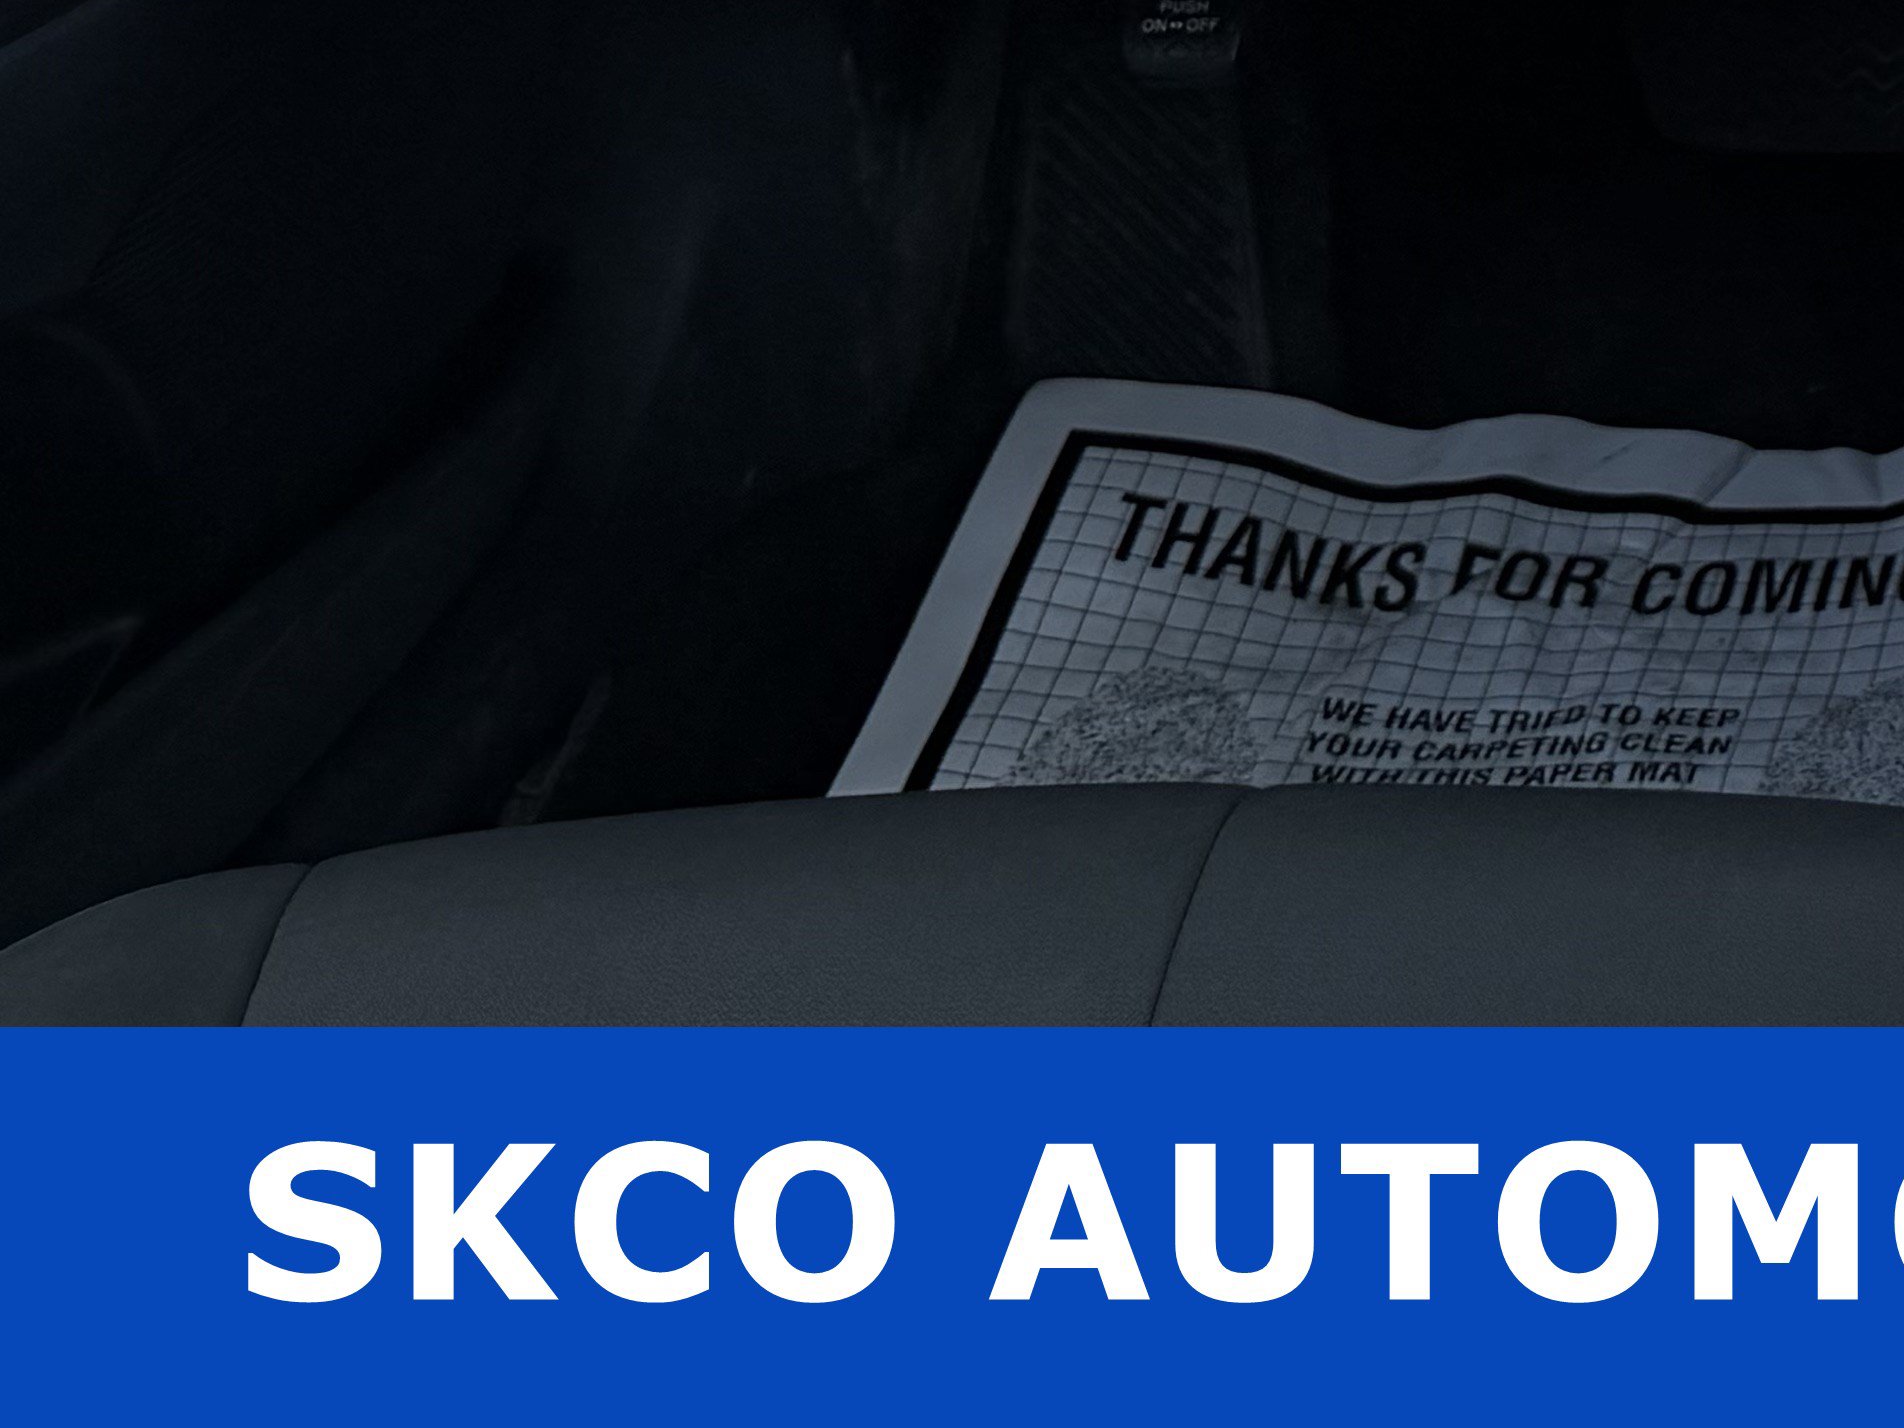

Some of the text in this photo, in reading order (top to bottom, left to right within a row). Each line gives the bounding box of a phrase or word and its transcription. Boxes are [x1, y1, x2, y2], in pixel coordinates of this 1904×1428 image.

[1141, 16, 1169, 34] ON
[1114, 493, 1427, 612] THANKS
[1449, 543, 1610, 609] FOR
[1322, 697, 1741, 735] WE HAVE TRIED TO KEEP
[1304, 731, 1732, 762] YOUR CARPETING CLEAN
[1311, 760, 1700, 787] WITH THIS PAPER MAT
